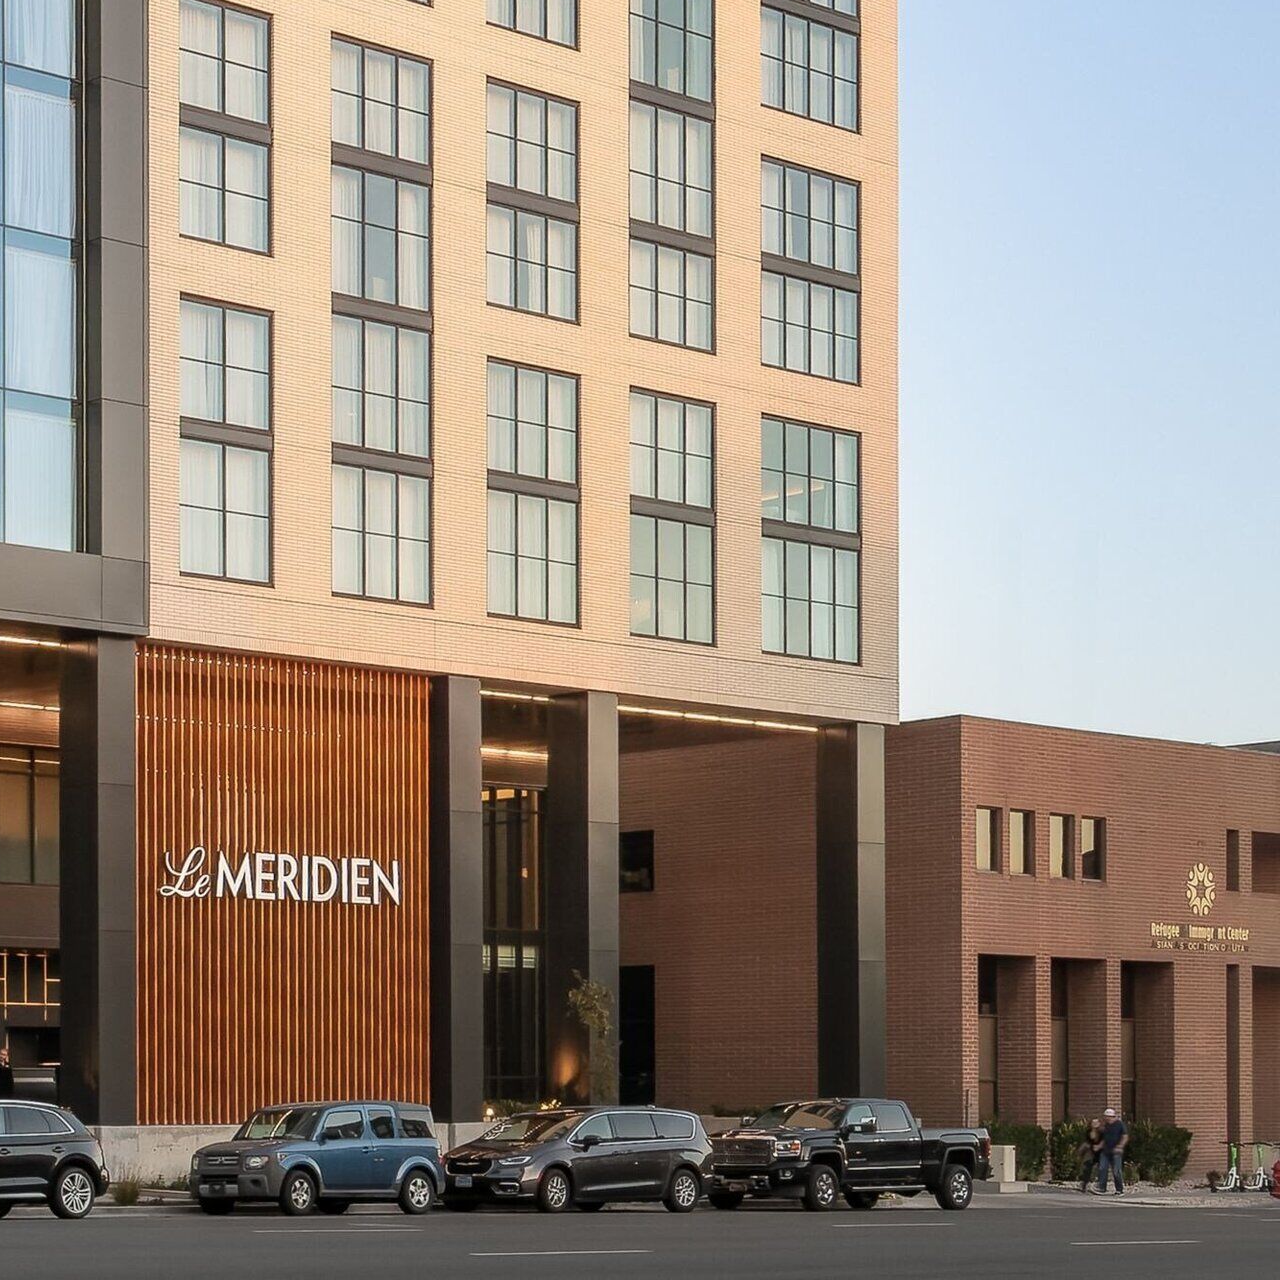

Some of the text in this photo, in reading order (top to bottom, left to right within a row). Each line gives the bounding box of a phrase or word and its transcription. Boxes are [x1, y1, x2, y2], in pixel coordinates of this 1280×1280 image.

[159, 846, 401, 906] Le MERIDIEN
[1151, 922, 1250, 942] Refugee Immigrnt Center
[1152, 940, 1173, 950] SIAN
